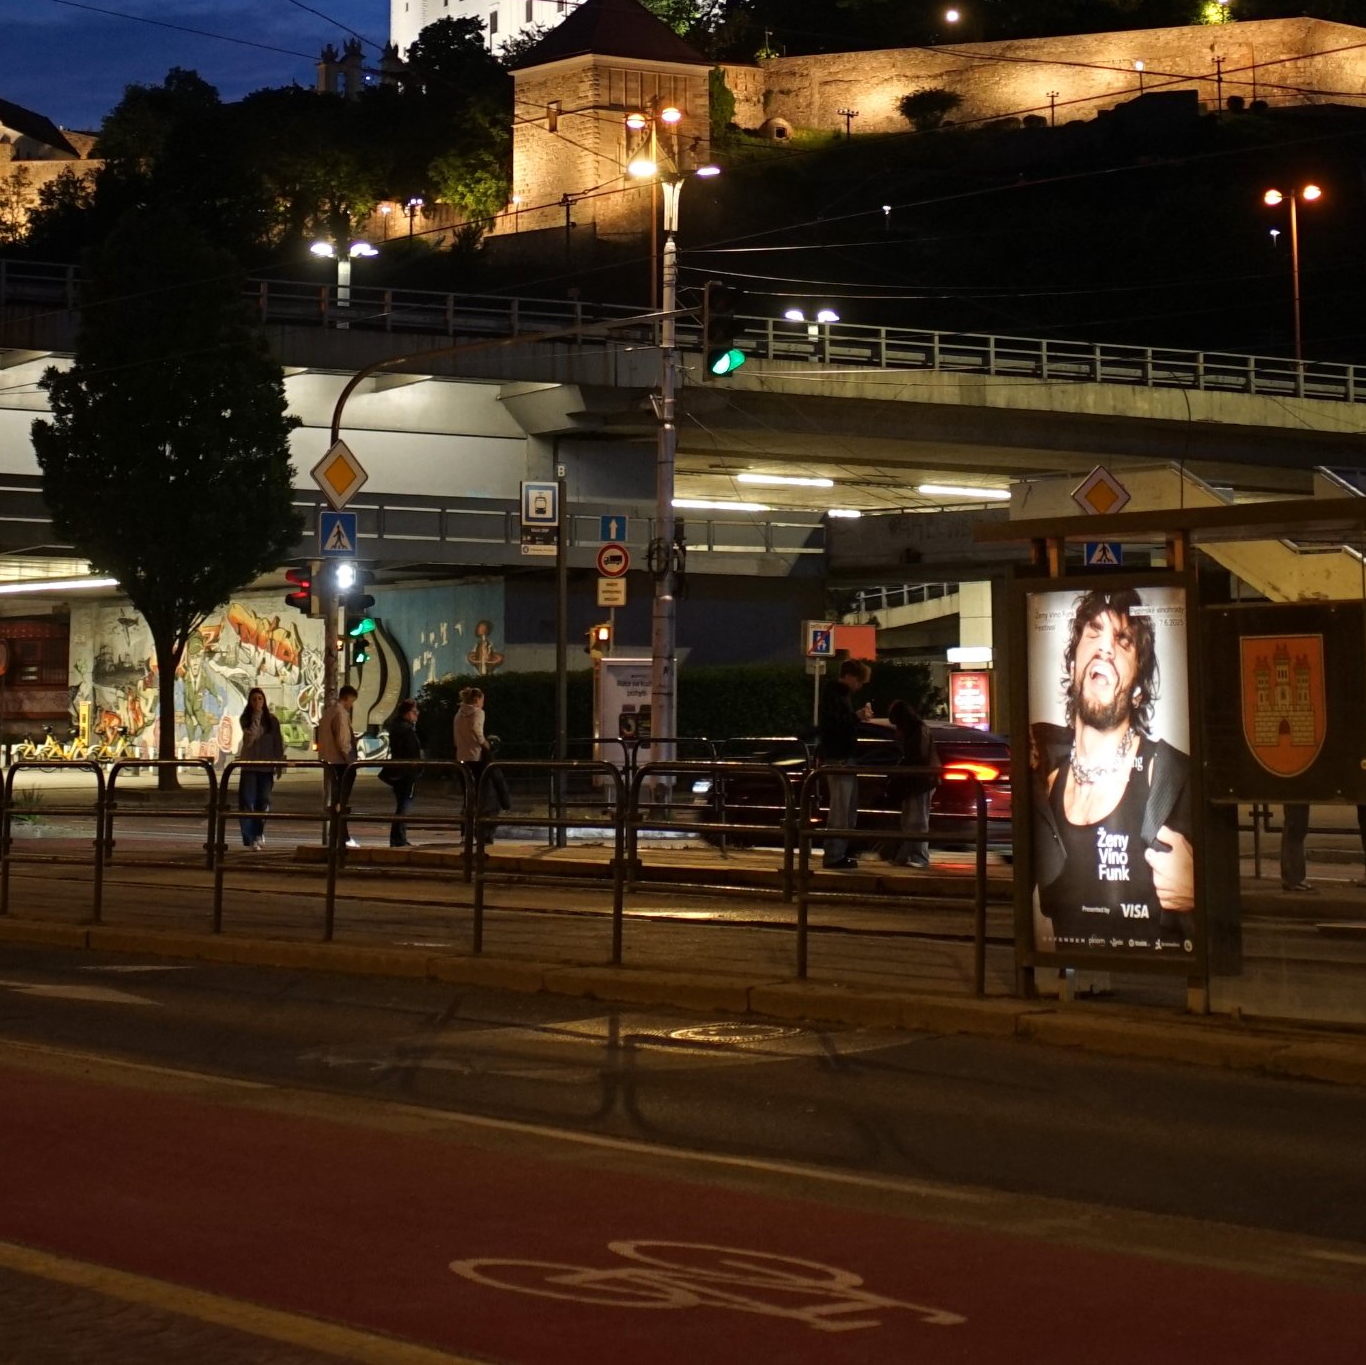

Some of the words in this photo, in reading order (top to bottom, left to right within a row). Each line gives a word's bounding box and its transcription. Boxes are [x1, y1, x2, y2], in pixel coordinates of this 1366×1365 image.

[557, 465, 565, 477] B
[1097, 827, 1129, 851] Ženy
[1098, 847, 1129, 865] Víno
[1098, 864, 1130, 881] Funk
[1120, 903, 1150, 919] VISA
